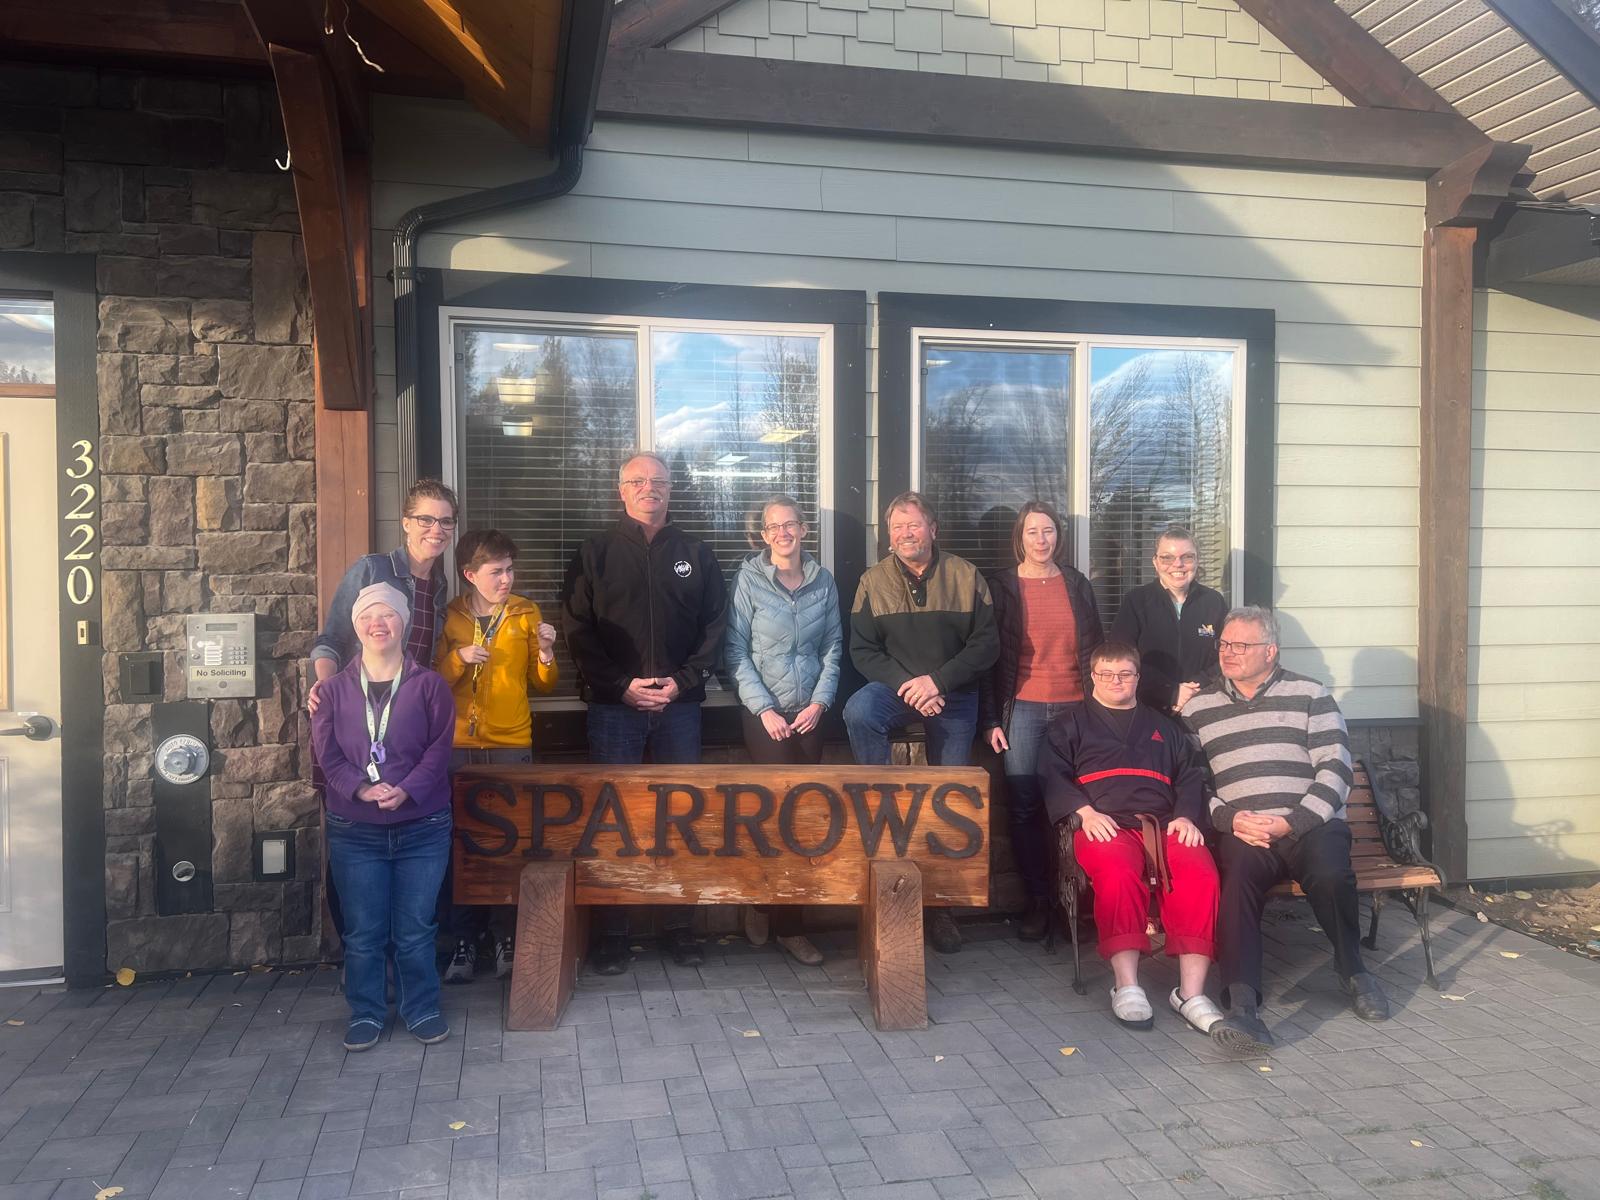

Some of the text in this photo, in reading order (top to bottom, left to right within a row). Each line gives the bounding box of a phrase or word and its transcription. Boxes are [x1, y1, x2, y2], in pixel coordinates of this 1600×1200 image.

[64, 439, 96, 605] 3220
[196, 669, 247, 677] No Soliciting
[460, 781, 985, 859] SPARROWS
